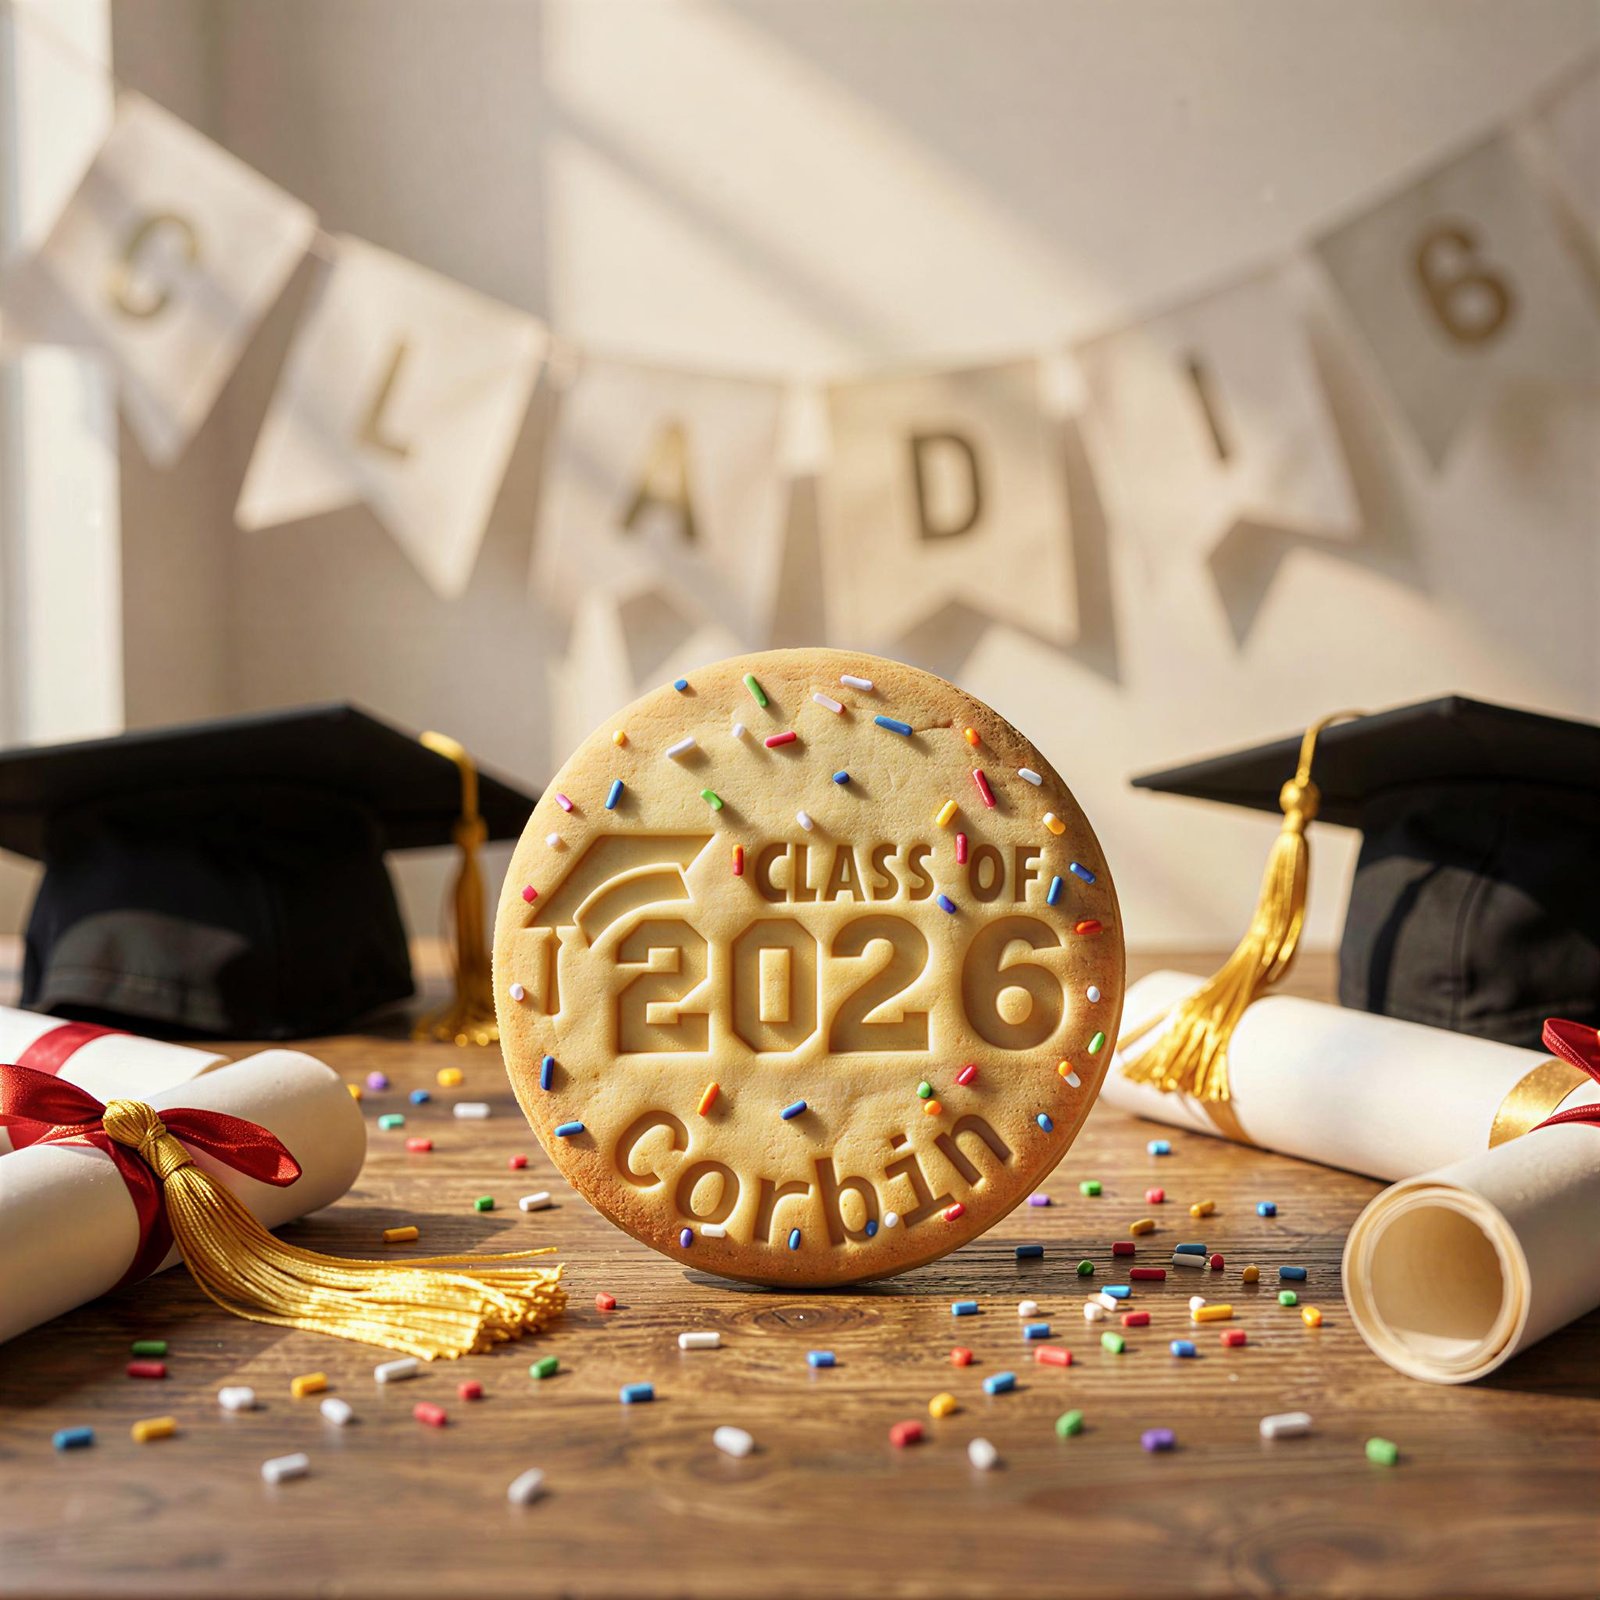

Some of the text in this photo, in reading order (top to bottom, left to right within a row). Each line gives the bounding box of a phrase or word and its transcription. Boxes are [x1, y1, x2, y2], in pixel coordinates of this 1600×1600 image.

[755, 842, 1042, 903] CLASS OF
[614, 915, 1065, 1054] 2026
[614, 1110, 1012, 1246] Corbin
